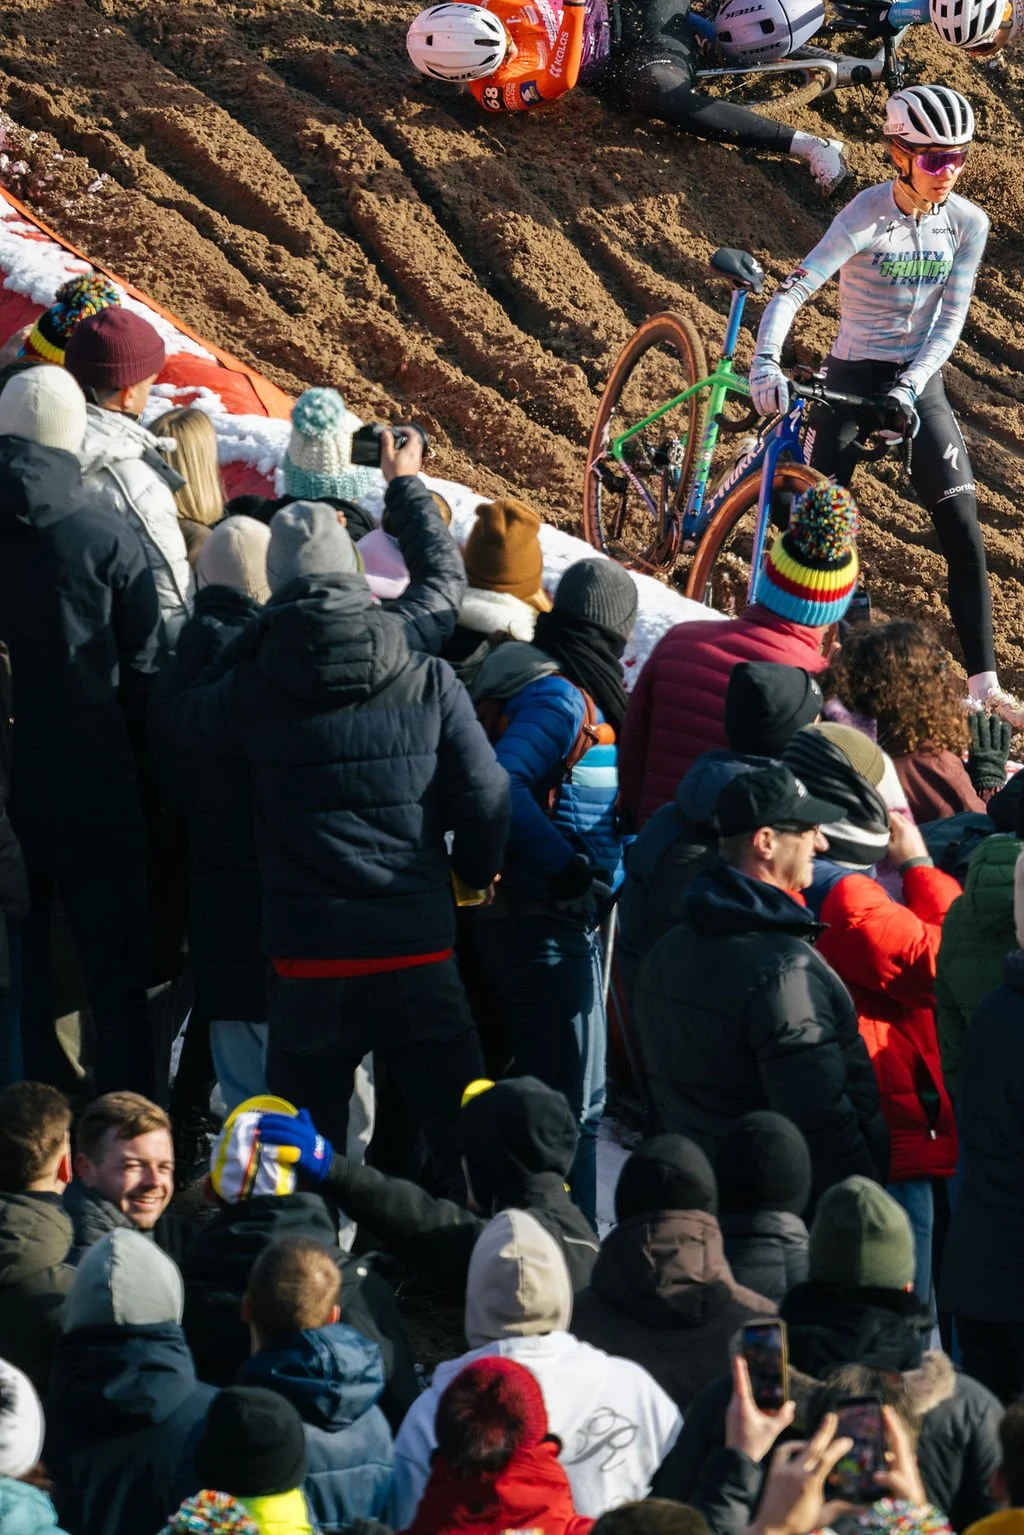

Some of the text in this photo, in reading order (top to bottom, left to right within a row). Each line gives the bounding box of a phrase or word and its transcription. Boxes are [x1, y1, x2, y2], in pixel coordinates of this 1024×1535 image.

[725, 5, 766, 20] TREK
[484, 86, 500, 110] 68
[880, 259, 952, 278] TRINITY
